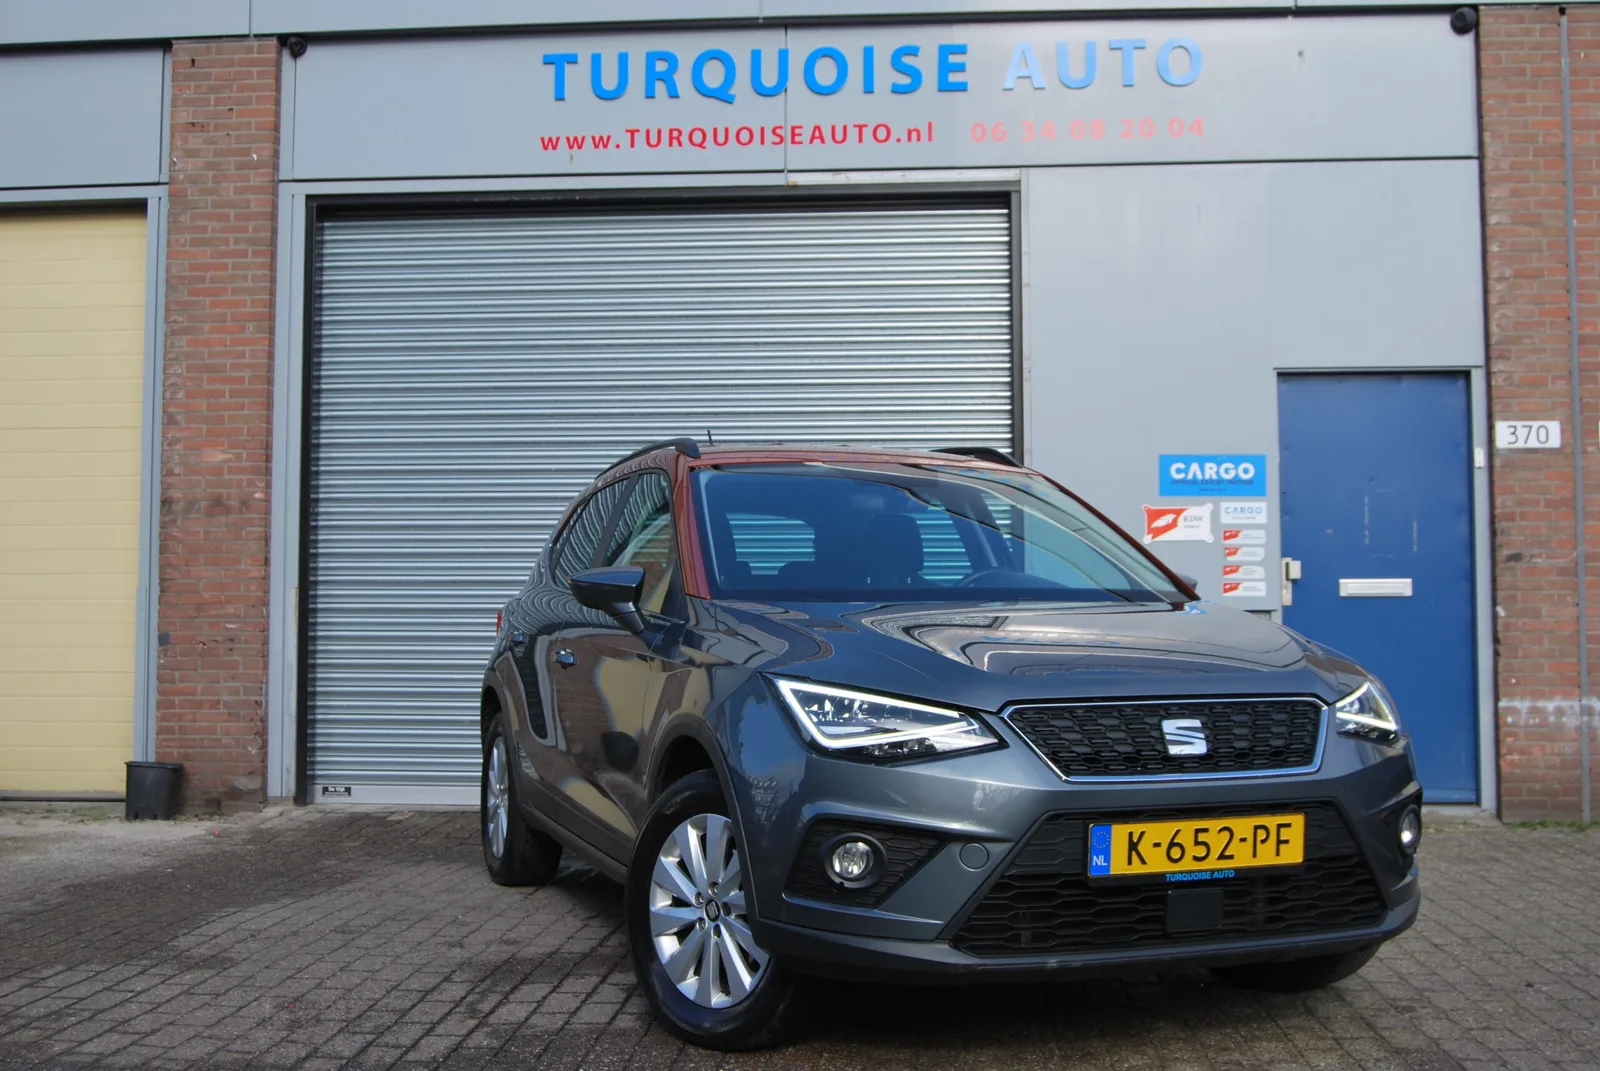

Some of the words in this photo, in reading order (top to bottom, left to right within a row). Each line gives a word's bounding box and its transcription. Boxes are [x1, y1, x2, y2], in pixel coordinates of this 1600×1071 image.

[543, 44, 969, 104] TURQUOISE
[1003, 38, 1204, 91] AUTO
[540, 122, 934, 150] www.TURQUOISEAUTO.nl
[971, 121, 1007, 143] 06
[1021, 120, 1057, 142] 34
[1069, 119, 1106, 141] 08
[1119, 118, 1156, 140] 20
[1168, 117, 1205, 138] 04
[1507, 425, 1549, 445] 370
[1169, 462, 1256, 480] CARGO
[1224, 506, 1263, 514] CARGO
[1127, 822, 1292, 866] K-652-PF
[1092, 855, 1108, 866] NL
[1165, 870, 1212, 882] TURQUOISE
[1212, 870, 1235, 880] AUTO
